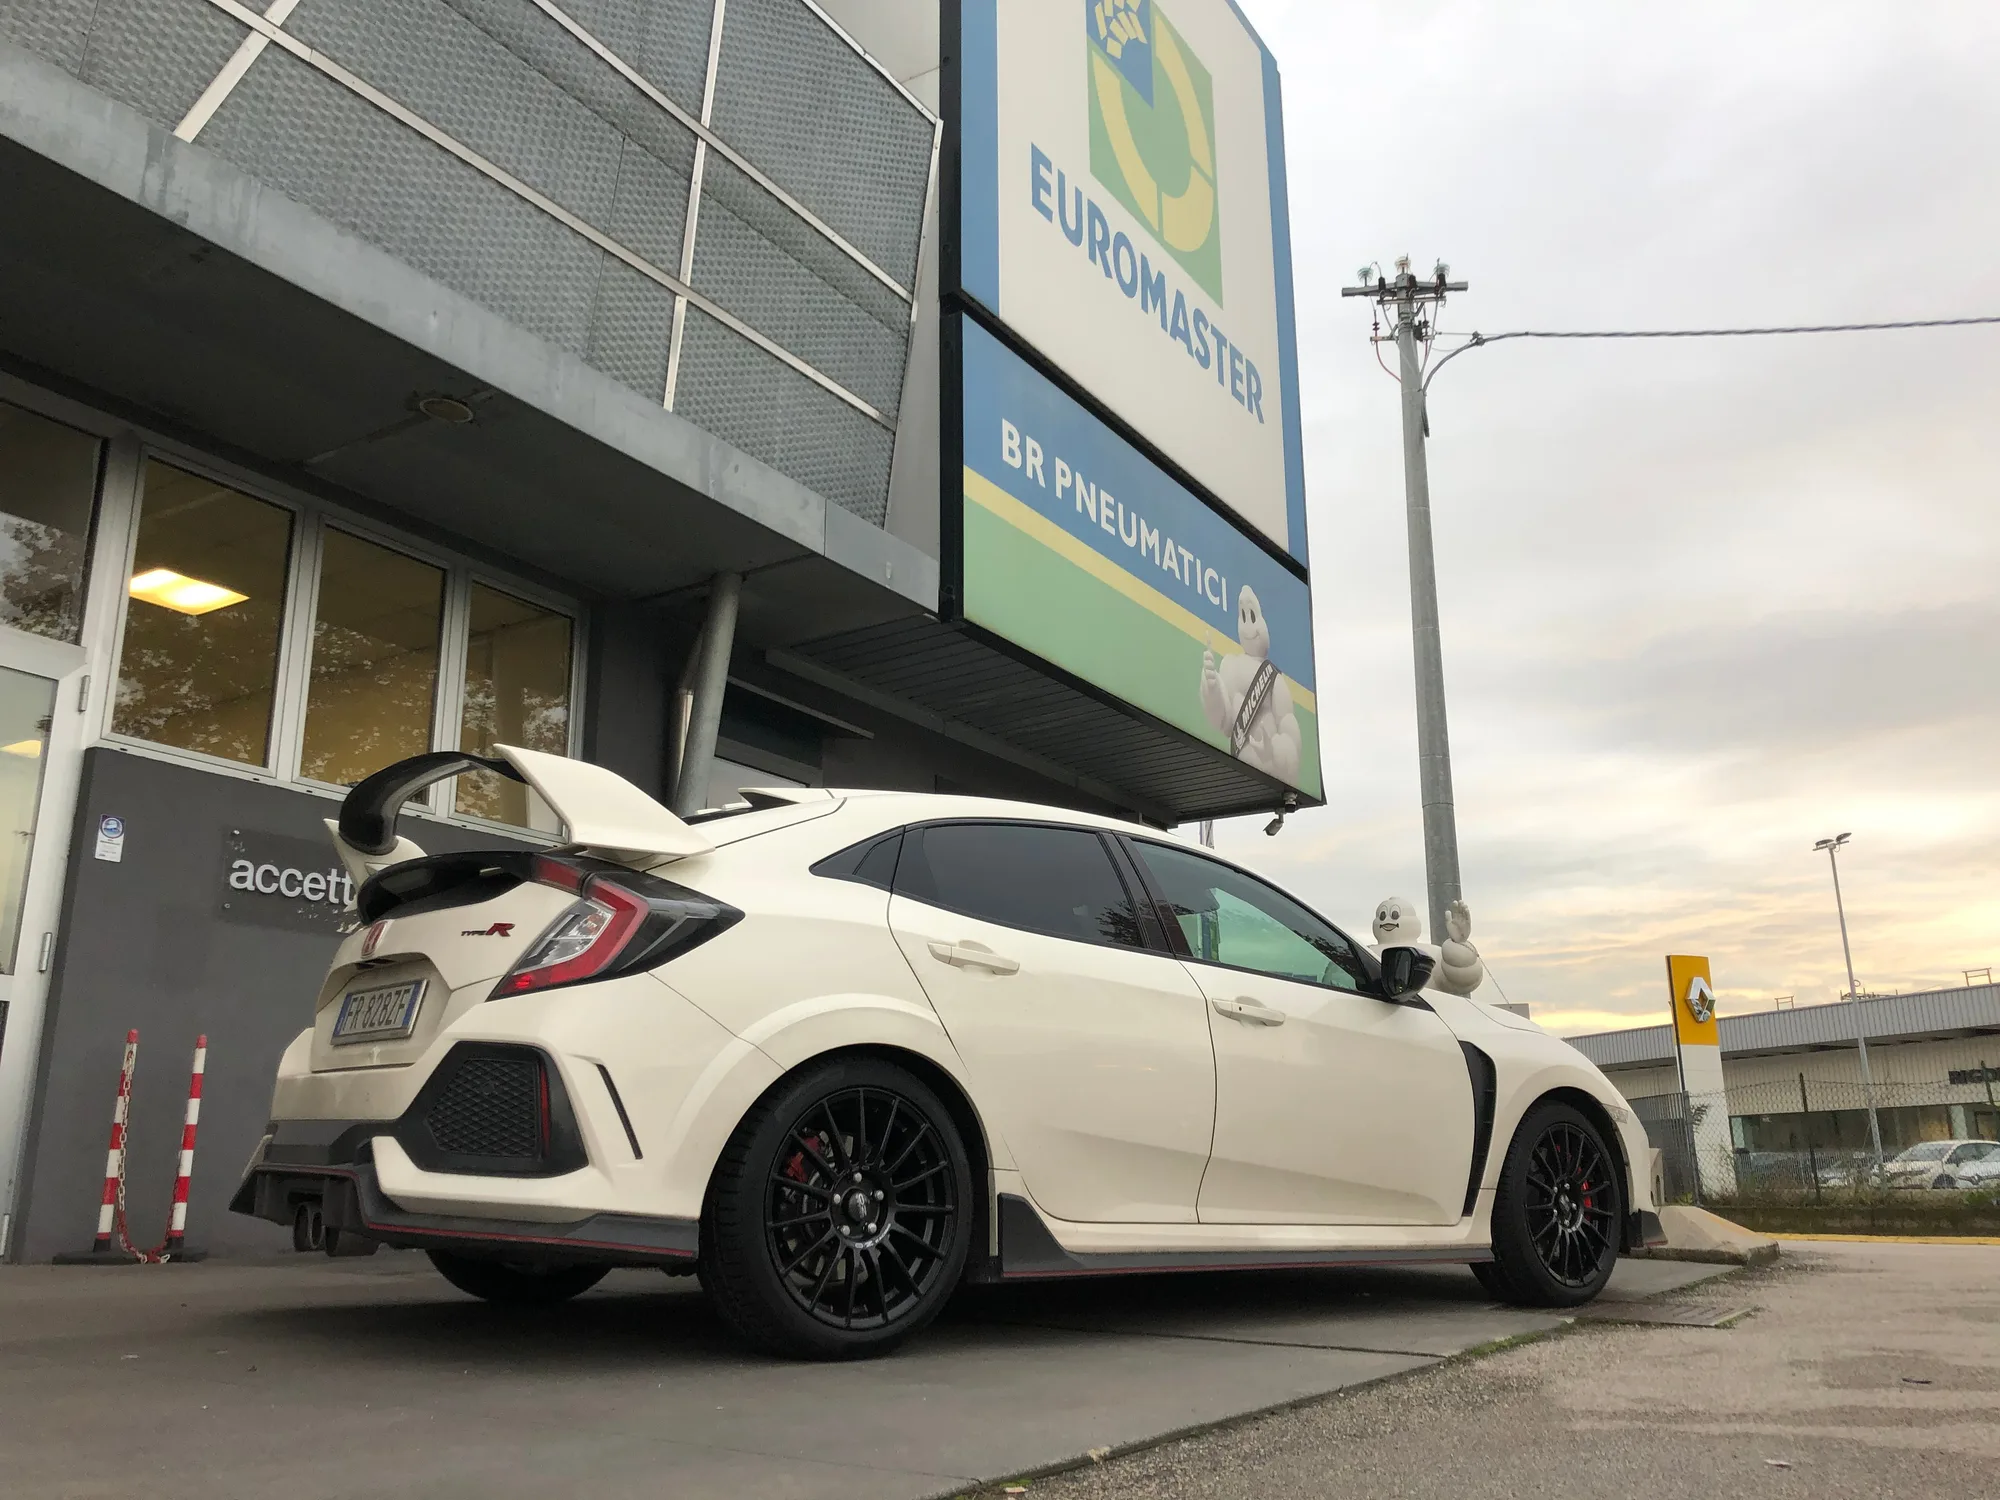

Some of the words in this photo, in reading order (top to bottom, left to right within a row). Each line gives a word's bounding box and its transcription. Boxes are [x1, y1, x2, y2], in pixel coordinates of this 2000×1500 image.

[1030, 141, 1265, 425] EUROMASTER
[1002, 417, 1046, 489] BR
[1055, 456, 1228, 613] PNEUMATICI
[1242, 663, 1274, 729] MICHELIN
